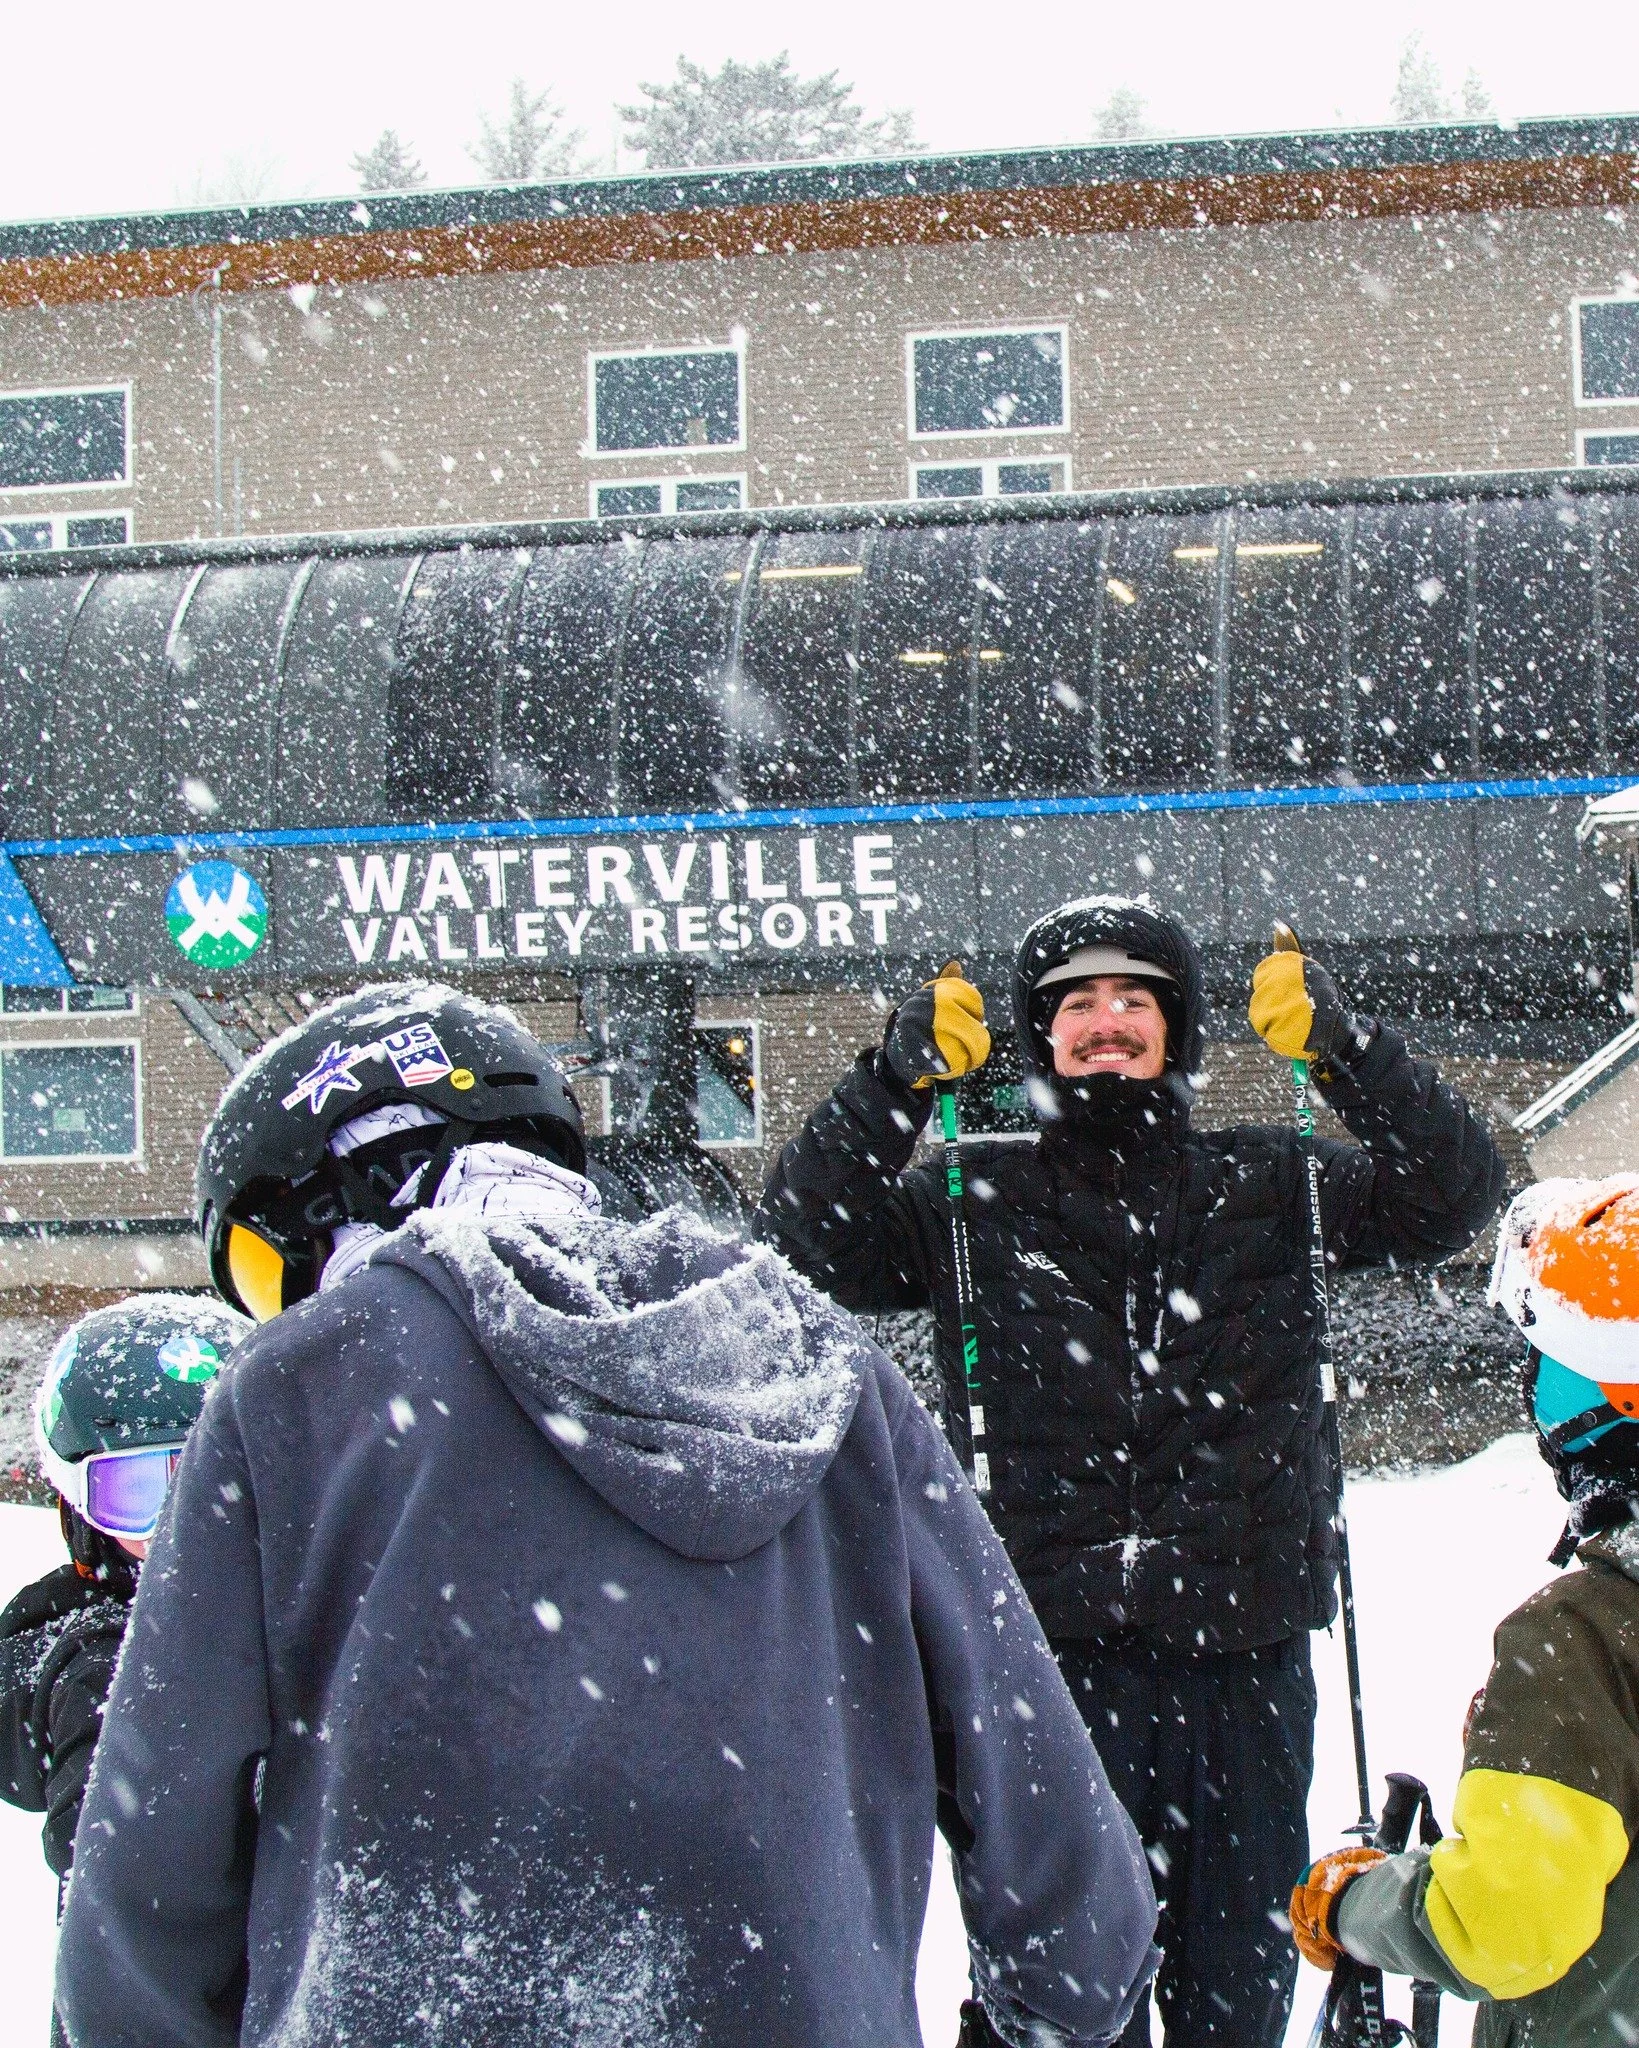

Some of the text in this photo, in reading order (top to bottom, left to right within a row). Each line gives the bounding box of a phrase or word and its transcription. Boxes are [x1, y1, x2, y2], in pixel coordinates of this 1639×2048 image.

[337, 834, 897, 913] WATERVILLE
[341, 899, 898, 963] VALLEY RESORT
[385, 1026, 432, 1051] US
[412, 1040, 438, 1053] TEAM
